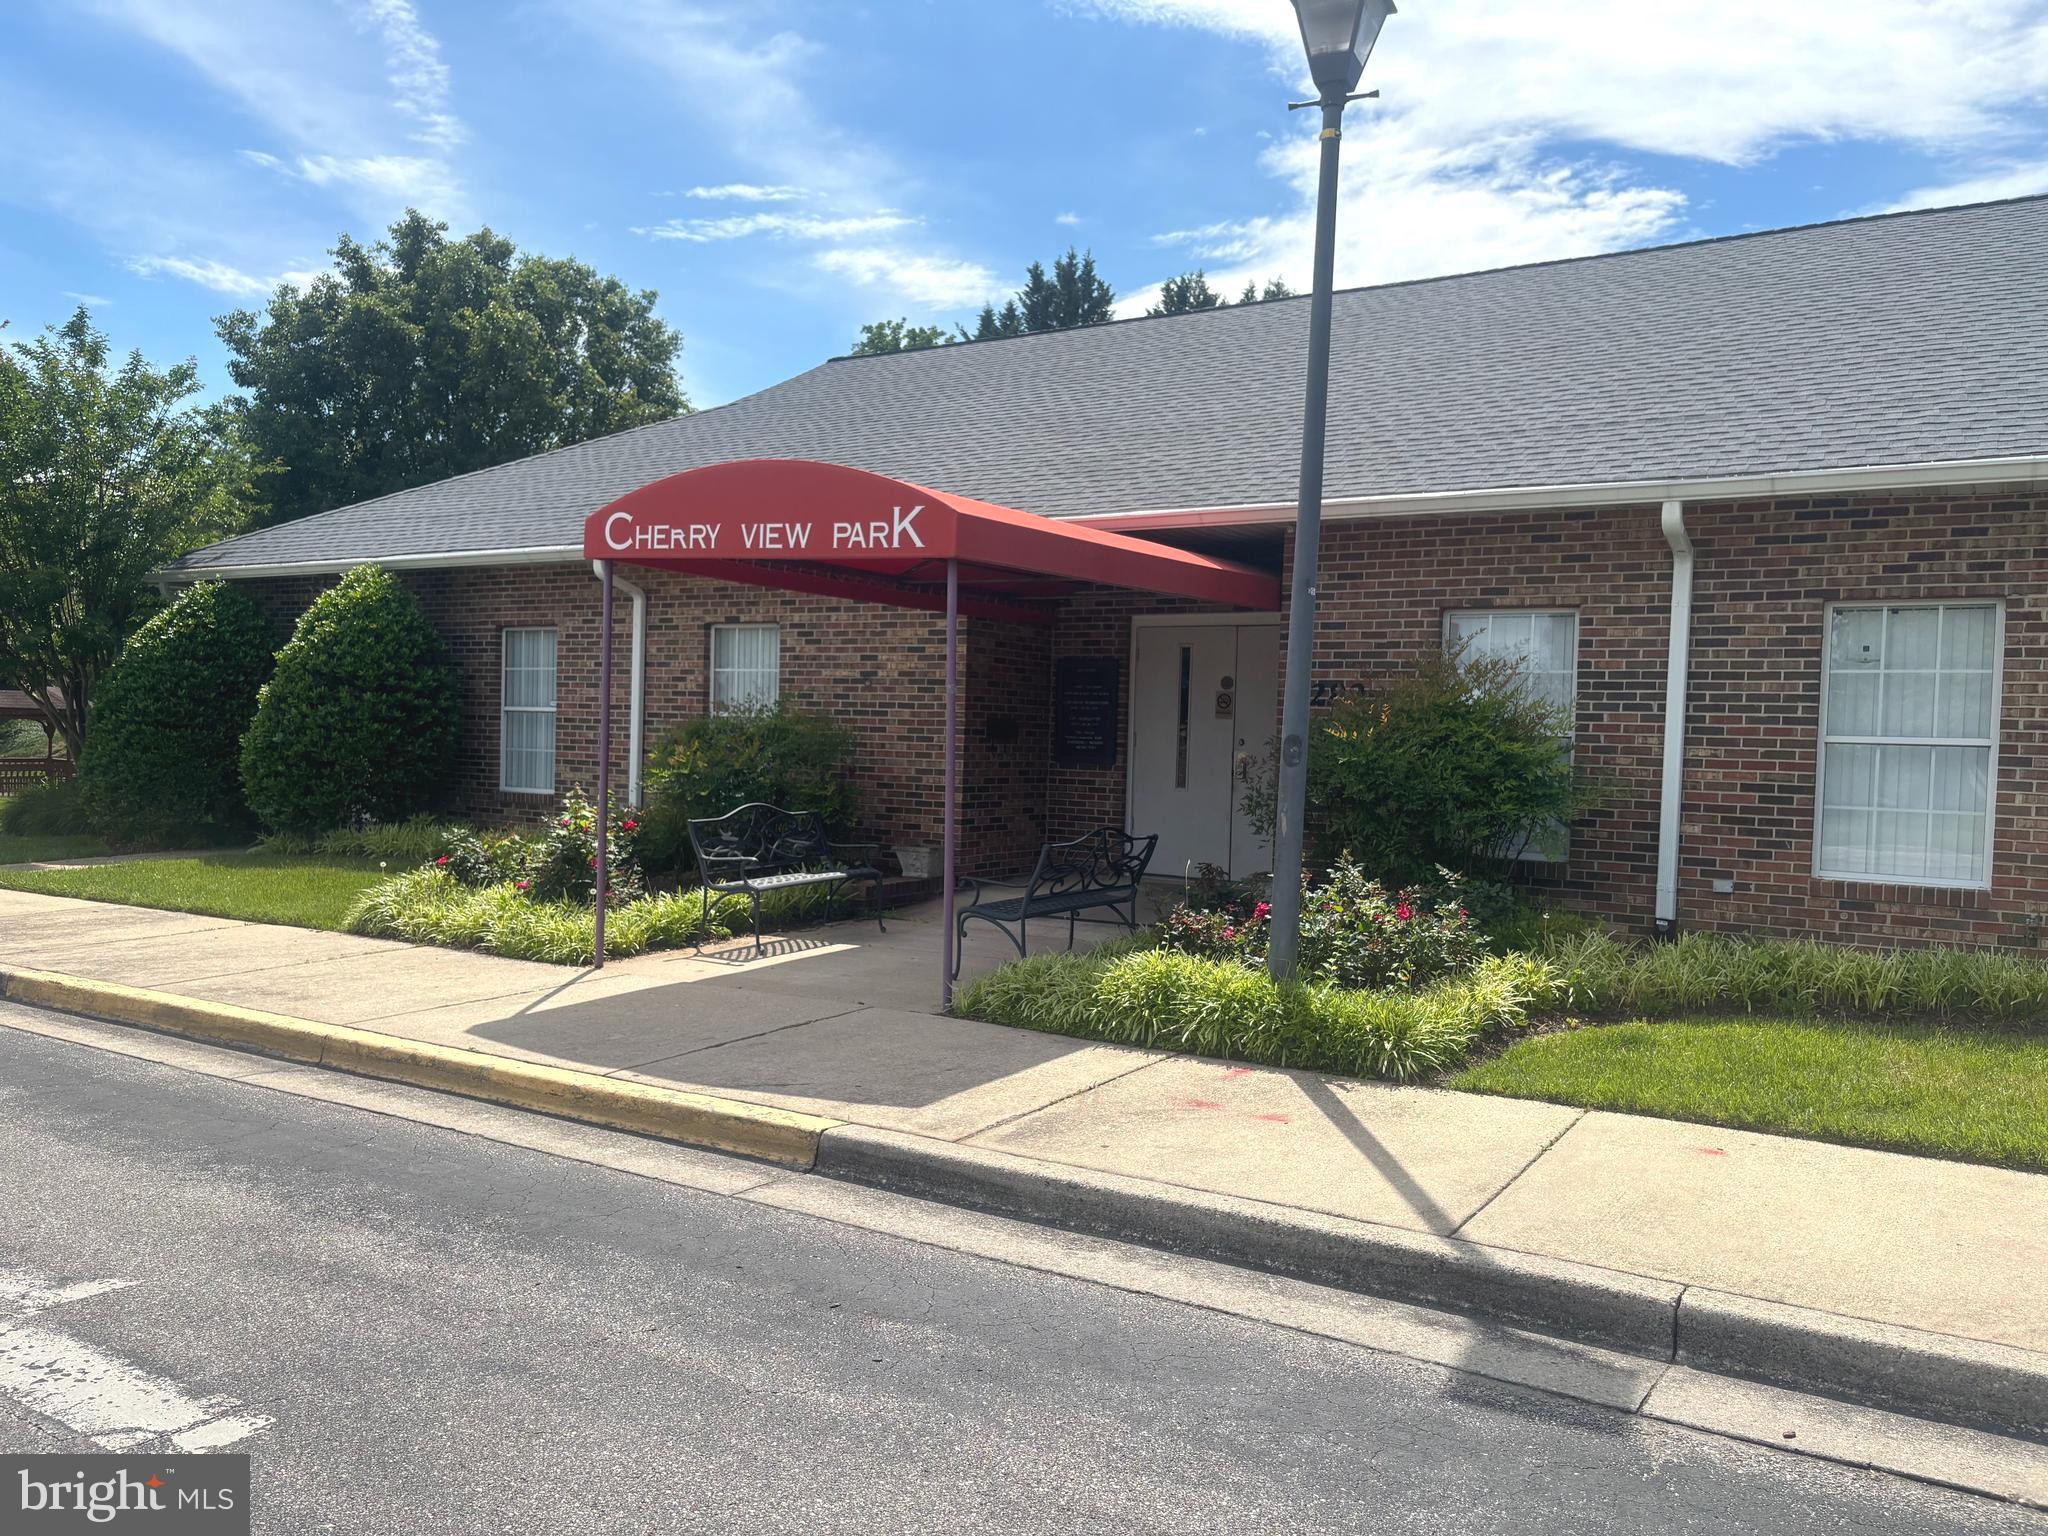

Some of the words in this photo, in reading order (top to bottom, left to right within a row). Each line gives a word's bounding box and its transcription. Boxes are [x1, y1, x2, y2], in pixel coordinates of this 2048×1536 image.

[604, 511, 721, 551] CHERRY
[741, 522, 812, 549] VIEW
[833, 505, 926, 549] PARK
